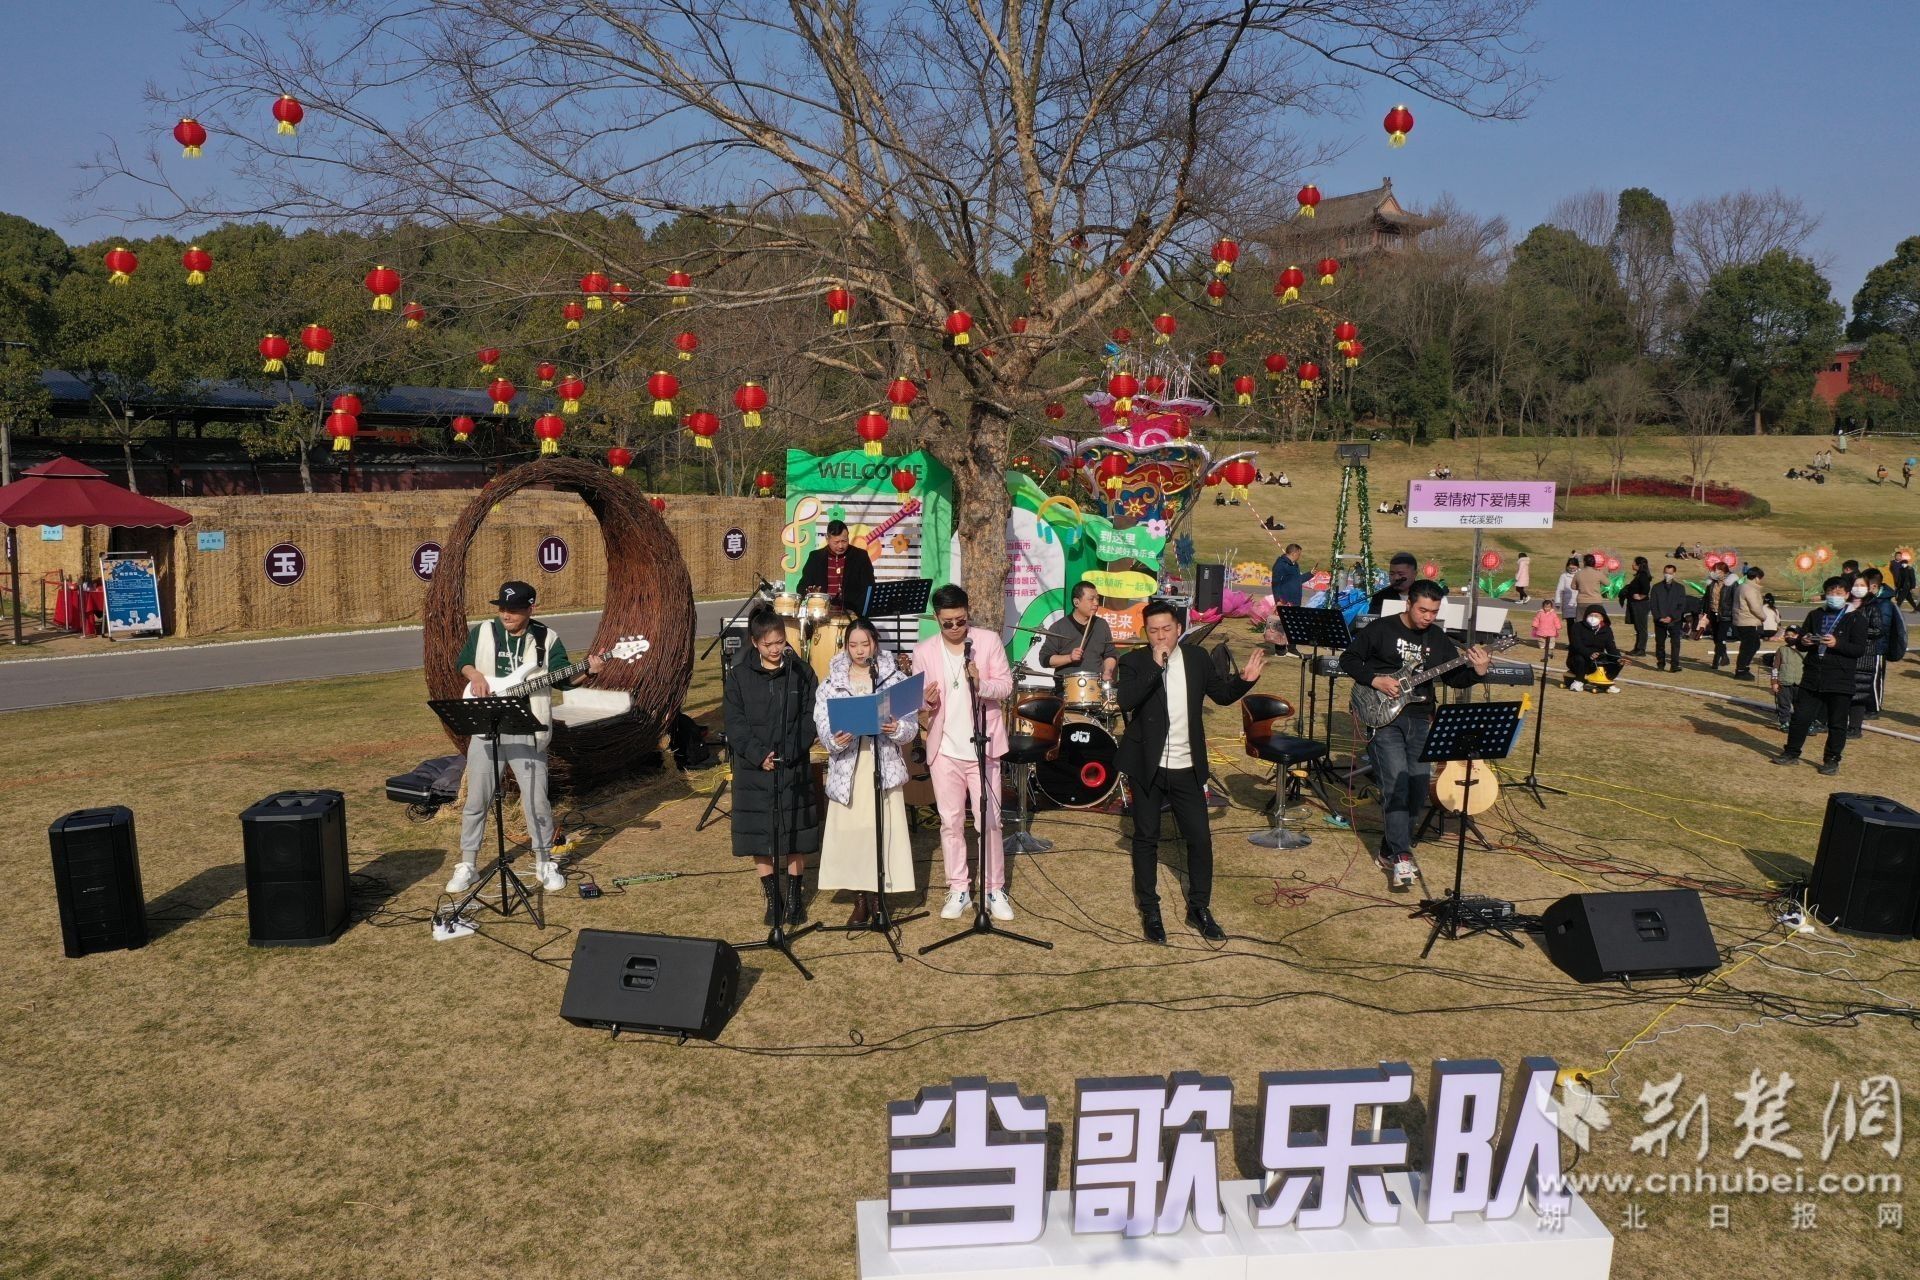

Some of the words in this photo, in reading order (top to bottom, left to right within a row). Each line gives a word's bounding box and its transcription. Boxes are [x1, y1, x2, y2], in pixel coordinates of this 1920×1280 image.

[1433, 491, 1531, 508] 爱情树下爱情果
[1413, 516, 1419, 524] S
[1460, 514, 1504, 525] 在花溪爱你
[1100, 530, 1136, 546] 到这里
[272, 552, 298, 577] 玉
[543, 543, 562, 566] 山
[726, 533, 743, 554] 草
[1095, 611, 1133, 629] 起来
[888, 1057, 1572, 1249] 当歌乐队
